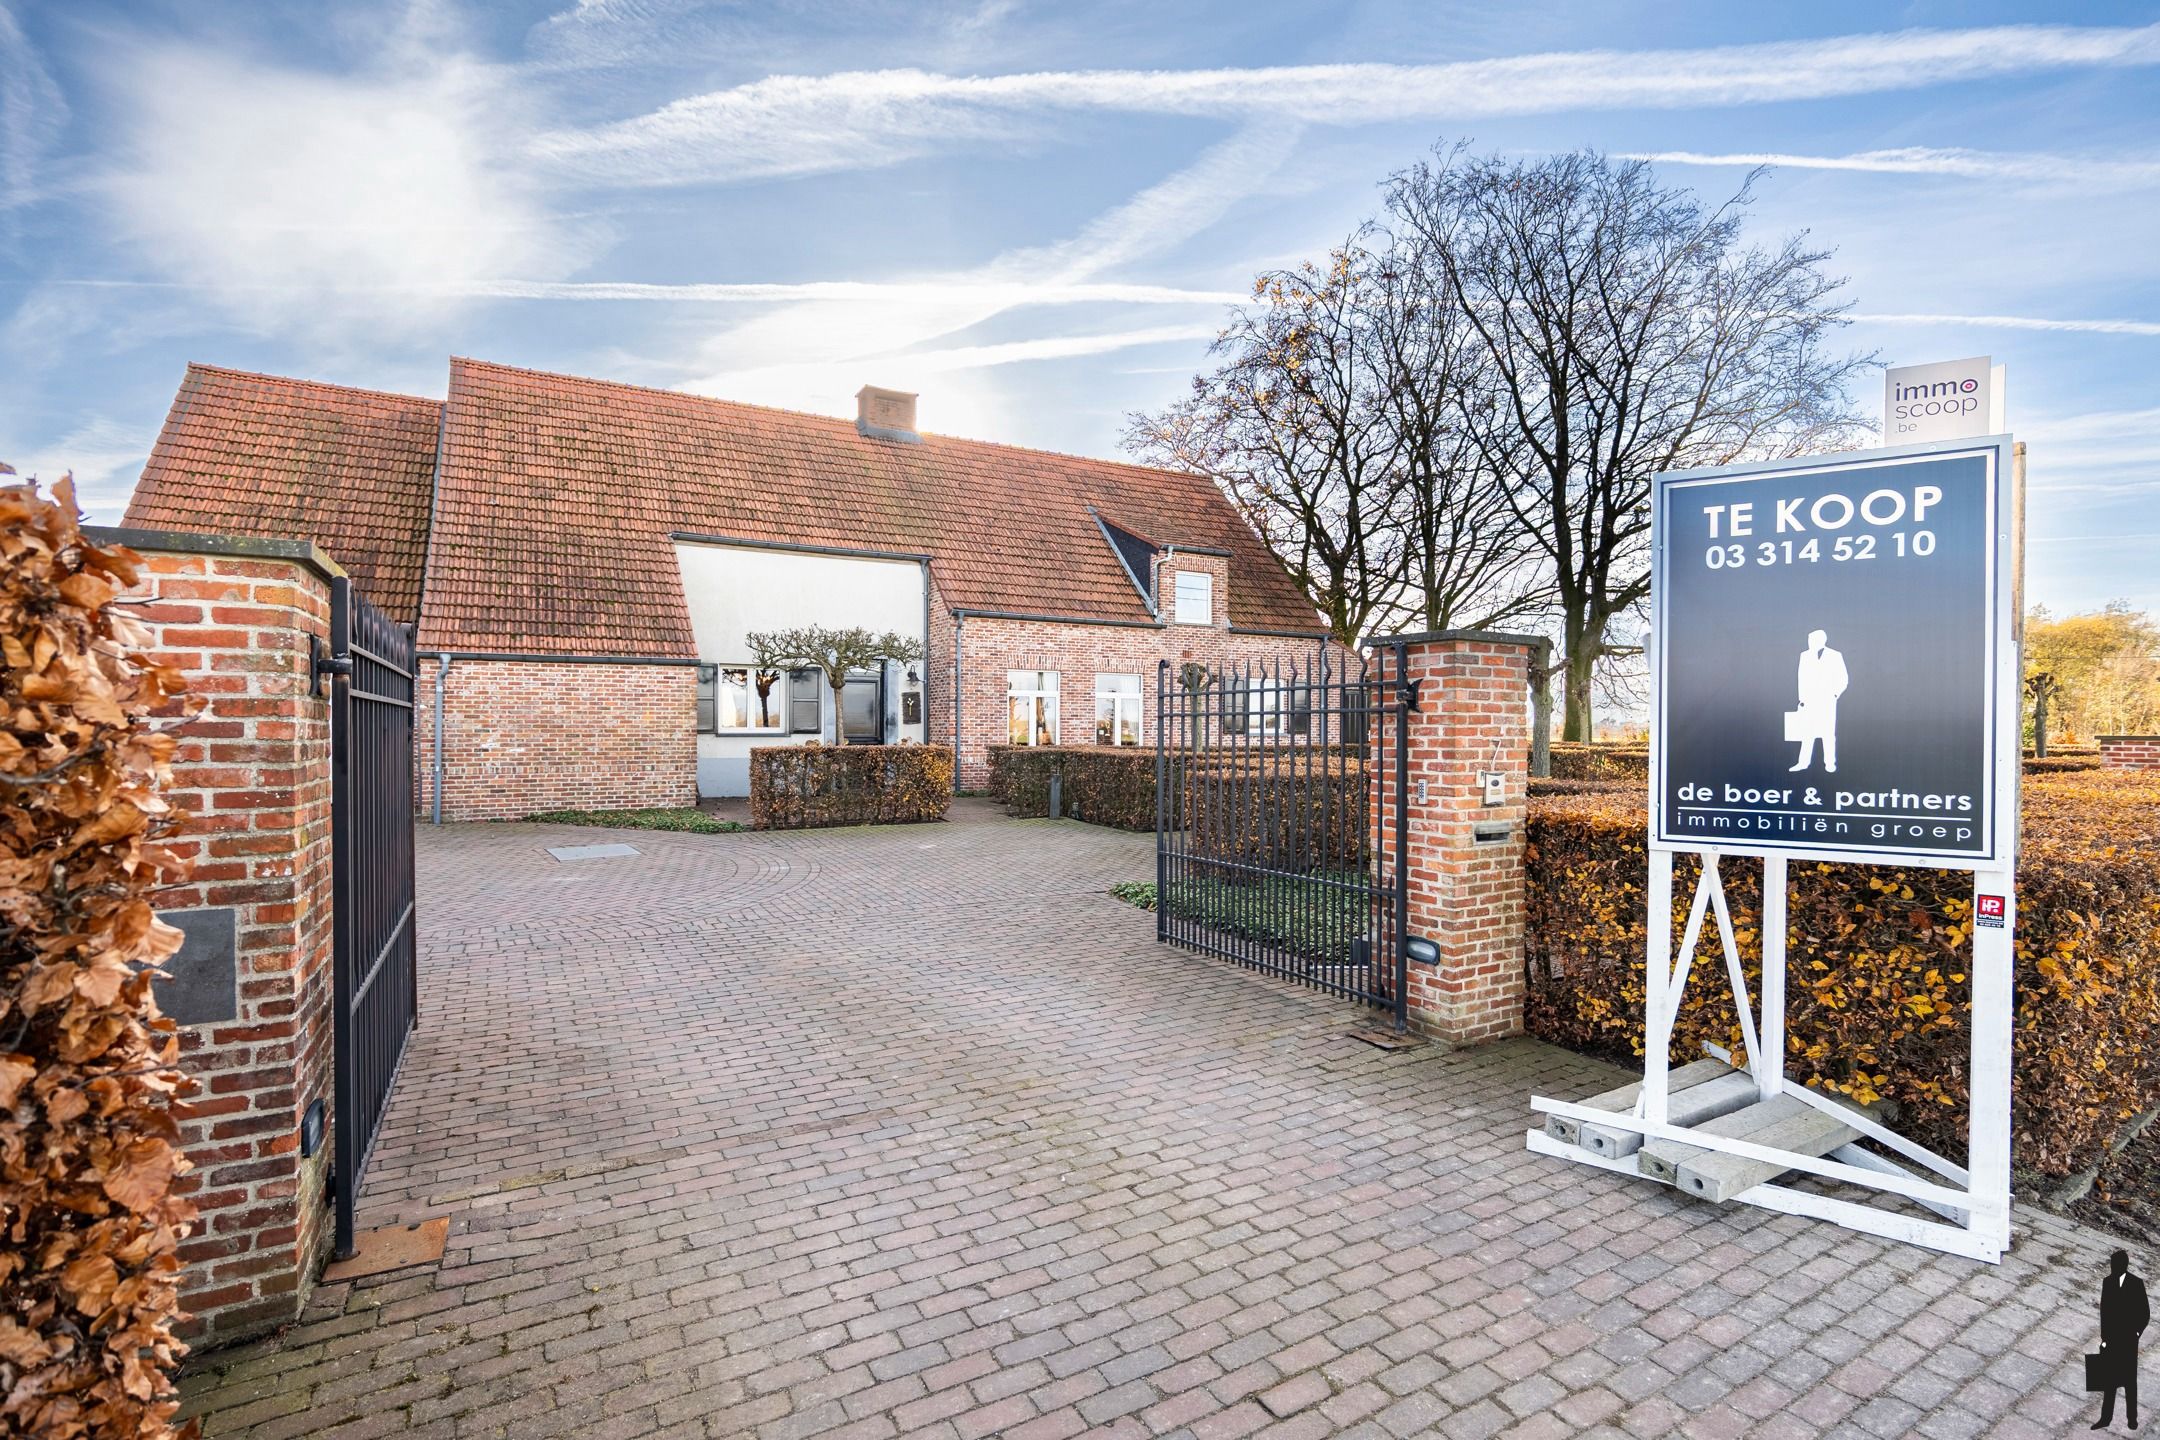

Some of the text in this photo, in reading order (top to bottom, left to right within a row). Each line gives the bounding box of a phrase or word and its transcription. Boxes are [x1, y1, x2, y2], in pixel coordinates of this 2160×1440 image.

[1895, 378, 1979, 402] immo
[1895, 397, 1978, 420] scoop
[1703, 485, 1943, 539] TE KOOP
[1705, 530, 1936, 570] 03 314 52 10
[1677, 782, 1972, 811] de boer & partners
[1677, 811, 1972, 842] immobiliën groep
